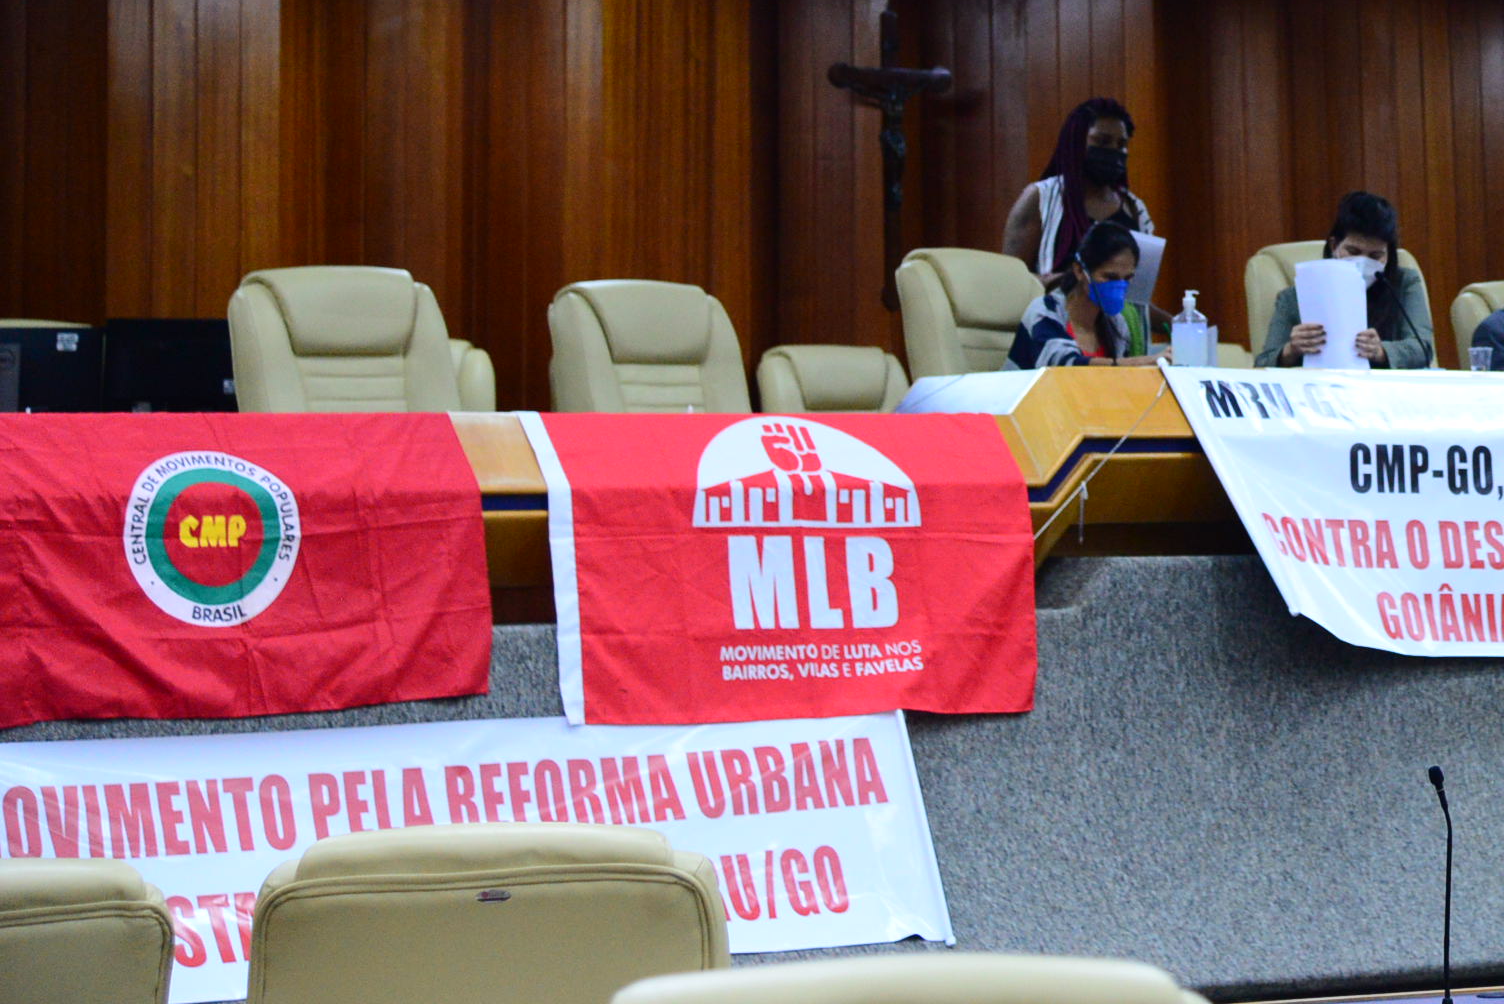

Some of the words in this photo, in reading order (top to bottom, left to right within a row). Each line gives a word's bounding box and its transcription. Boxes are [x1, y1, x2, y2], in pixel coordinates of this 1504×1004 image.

[1349, 442, 1504, 500] CMP-GO,
[130, 497, 149, 565] CENTRAL
[142, 476, 159, 492] DE
[155, 455, 256, 478] MOVIMENTOS
[260, 475, 296, 561] POPULARES
[179, 514, 247, 548] CMP
[1262, 512, 1399, 569] CONTRA
[1405, 519, 1430, 570] O
[728, 535, 899, 630] MLB
[192, 604, 247, 622] BRASIL
[720, 644, 818, 662] MOVIMENTO
[821, 645, 840, 660] DE
[844, 643, 882, 659] LUTA
[882, 640, 922, 656] NOS
[722, 664, 794, 681] BAIRROS,
[796, 663, 839, 678] VILAS
[843, 663, 852, 677] E
[855, 656, 924, 676] FAVELAS
[0, 774, 297, 859] OVIMENTO
[444, 754, 686, 825] REFORMA
[686, 737, 890, 819] URBANA
